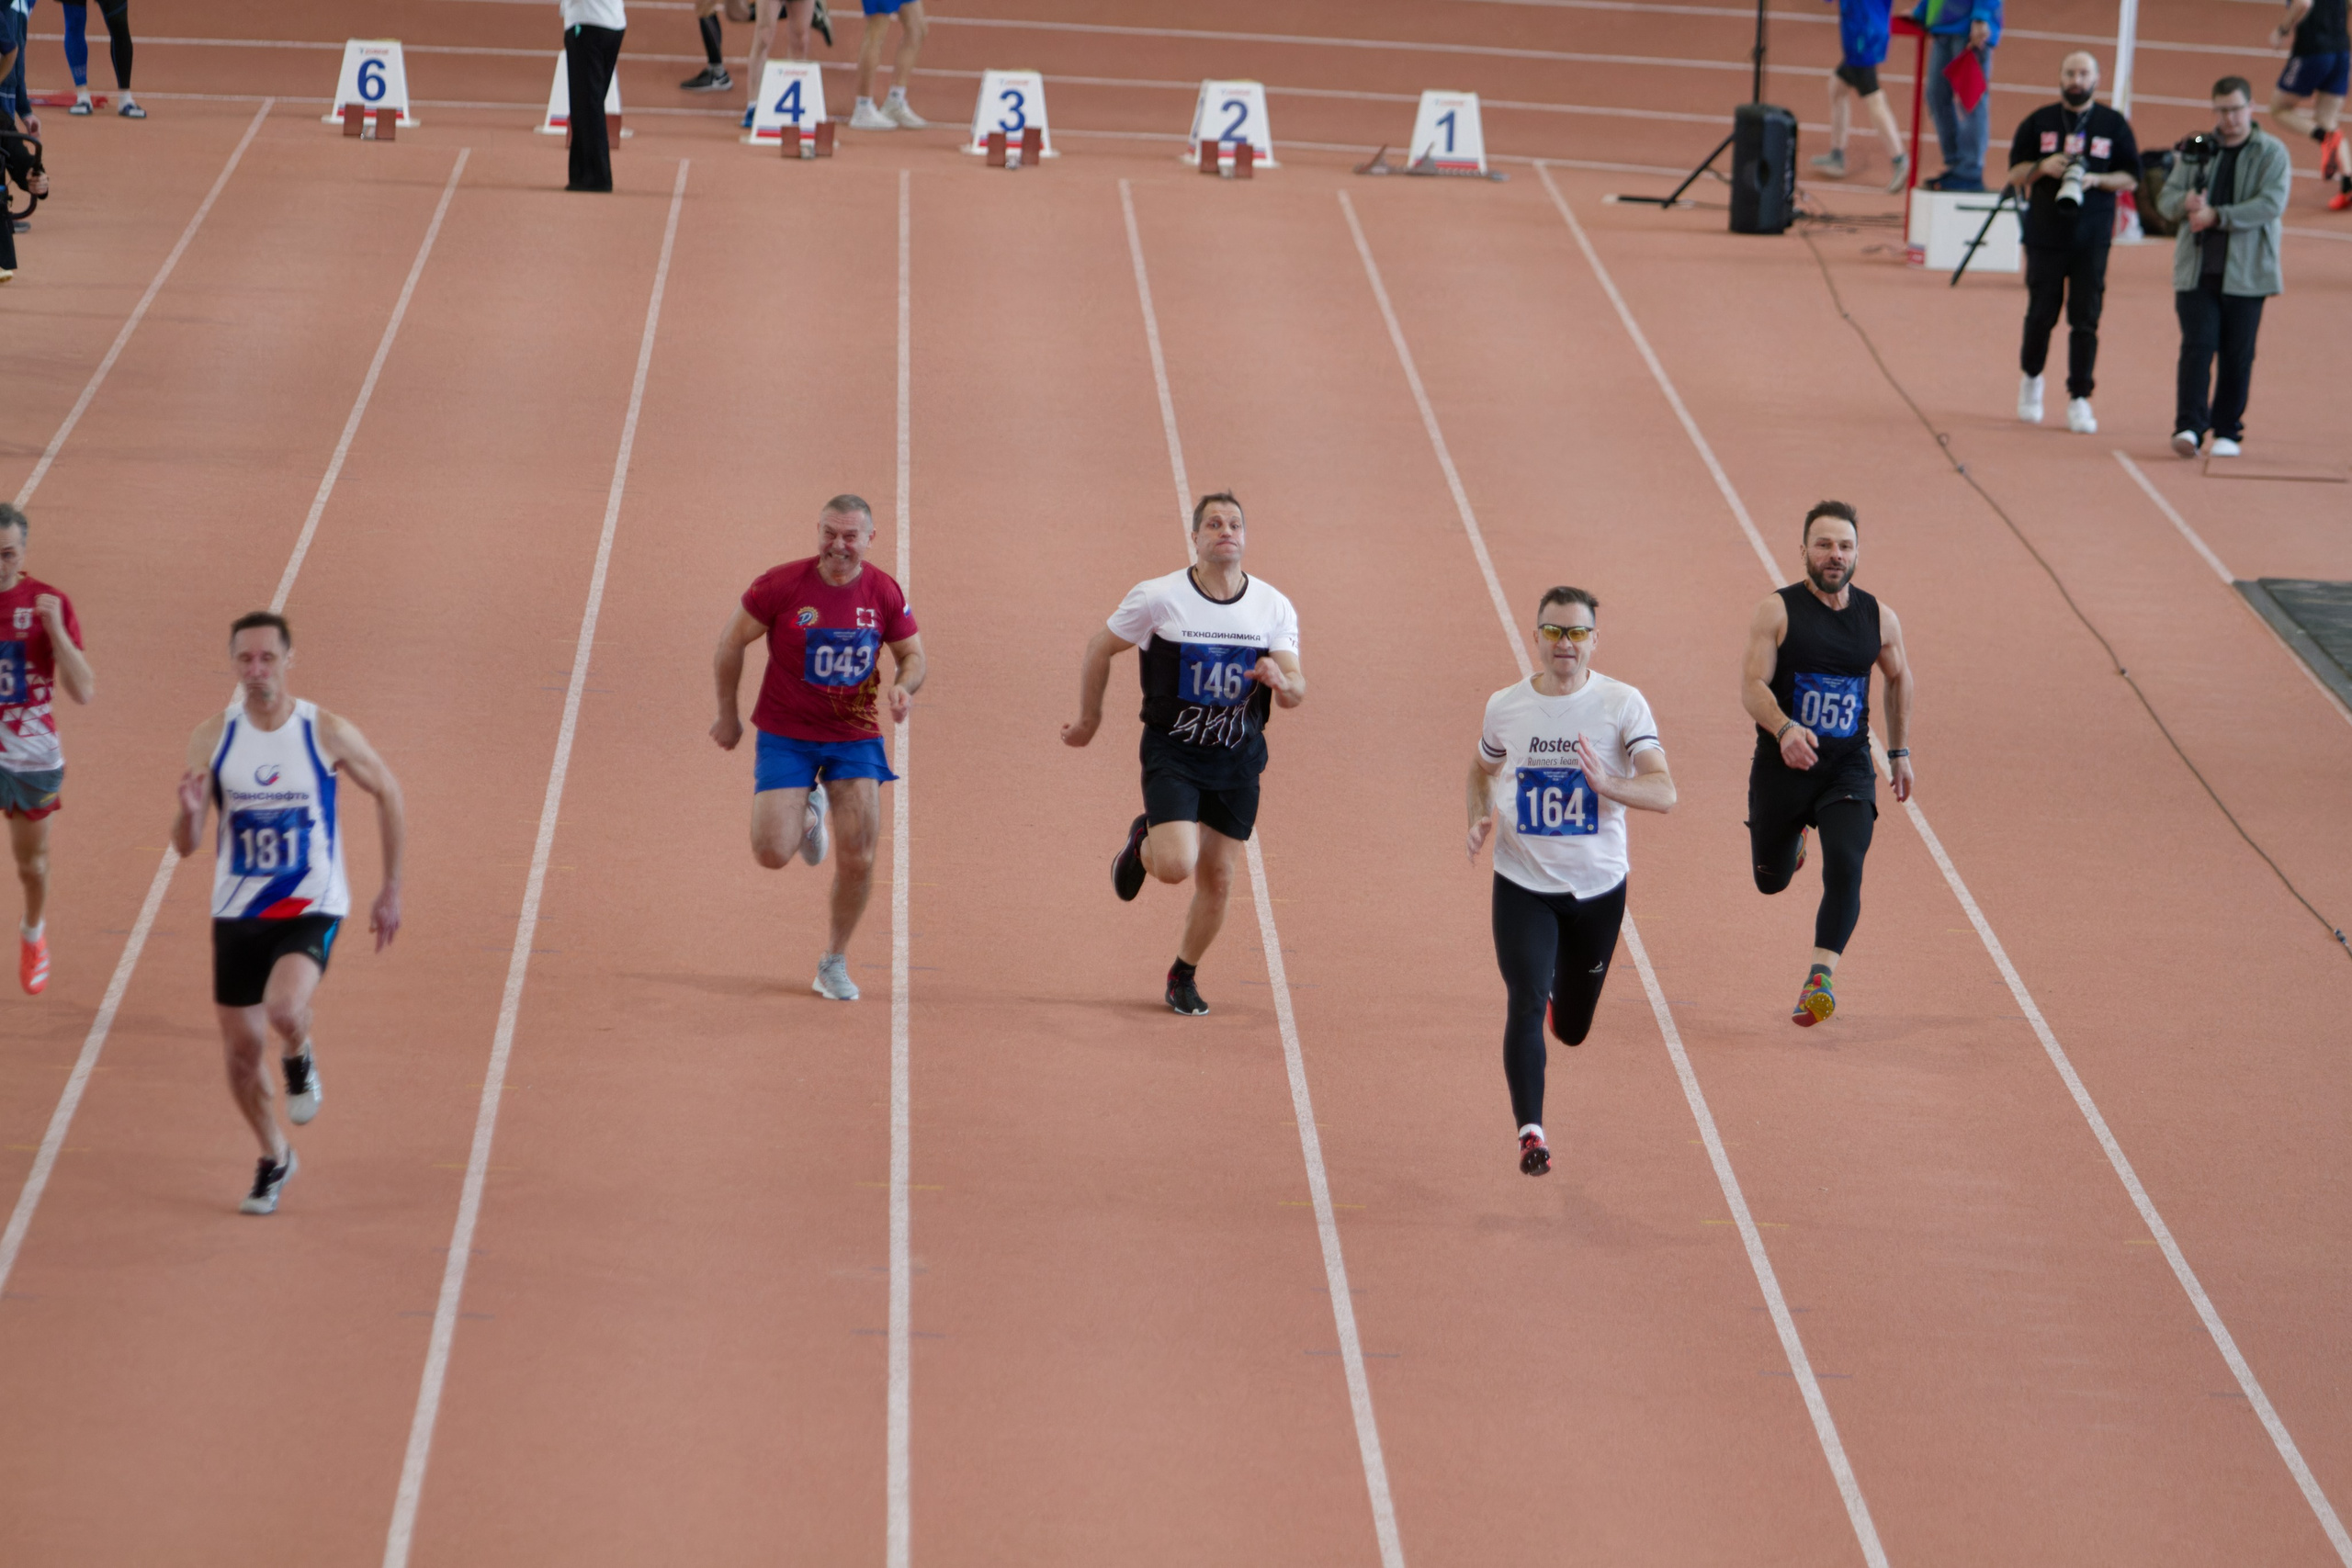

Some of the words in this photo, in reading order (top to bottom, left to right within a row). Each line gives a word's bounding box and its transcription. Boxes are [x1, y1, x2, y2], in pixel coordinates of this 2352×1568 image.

[356, 59, 387, 102] 6
[774, 80, 806, 122] 4
[998, 89, 1025, 132] 3
[1219, 99, 1249, 142] 2
[1435, 110, 1455, 153] 1
[1182, 629, 1261, 642] ТЕХНОДИНАМИКА
[0, 659, 15, 696] 6
[813, 645, 872, 678] 043
[1190, 661, 1244, 700] 146
[1800, 690, 1857, 730] 053
[1527, 757, 1558, 767] Runners
[1559, 756, 1579, 766] Team
[1529, 737, 1579, 753] Rostec
[226, 789, 310, 802] Транснефть
[1525, 786, 1586, 829] 164
[239, 826, 299, 870] 181
